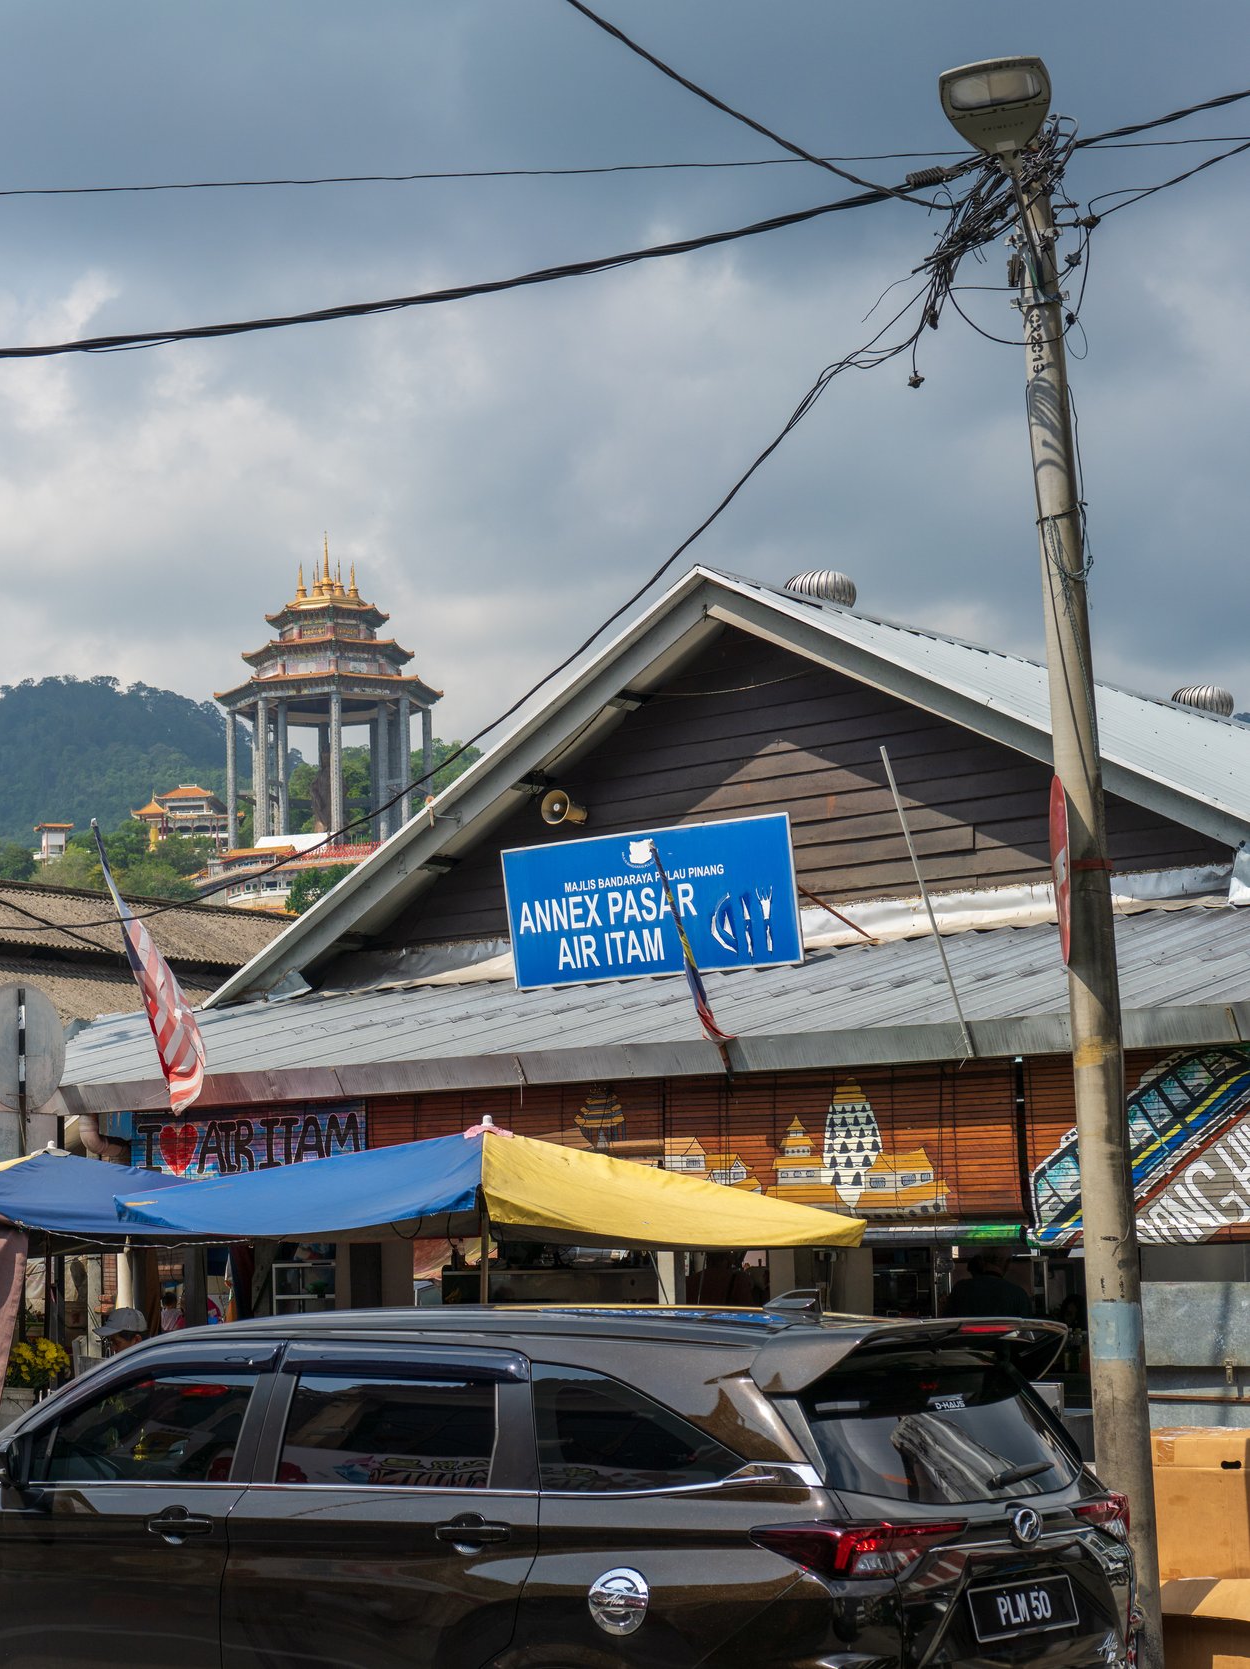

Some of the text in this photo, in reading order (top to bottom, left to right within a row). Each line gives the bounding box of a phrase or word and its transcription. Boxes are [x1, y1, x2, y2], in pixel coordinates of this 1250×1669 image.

[564, 879, 596, 893] MAJLIS
[598, 873, 653, 889] BANDARAYA
[688, 864, 724, 879] PINANG
[519, 883, 698, 934] ANNEX PASAR
[558, 928, 665, 970] AIR ITAM
[137, 1112, 361, 1174] I AIR ITAM
[996, 1590, 1052, 1626] PLM 50
